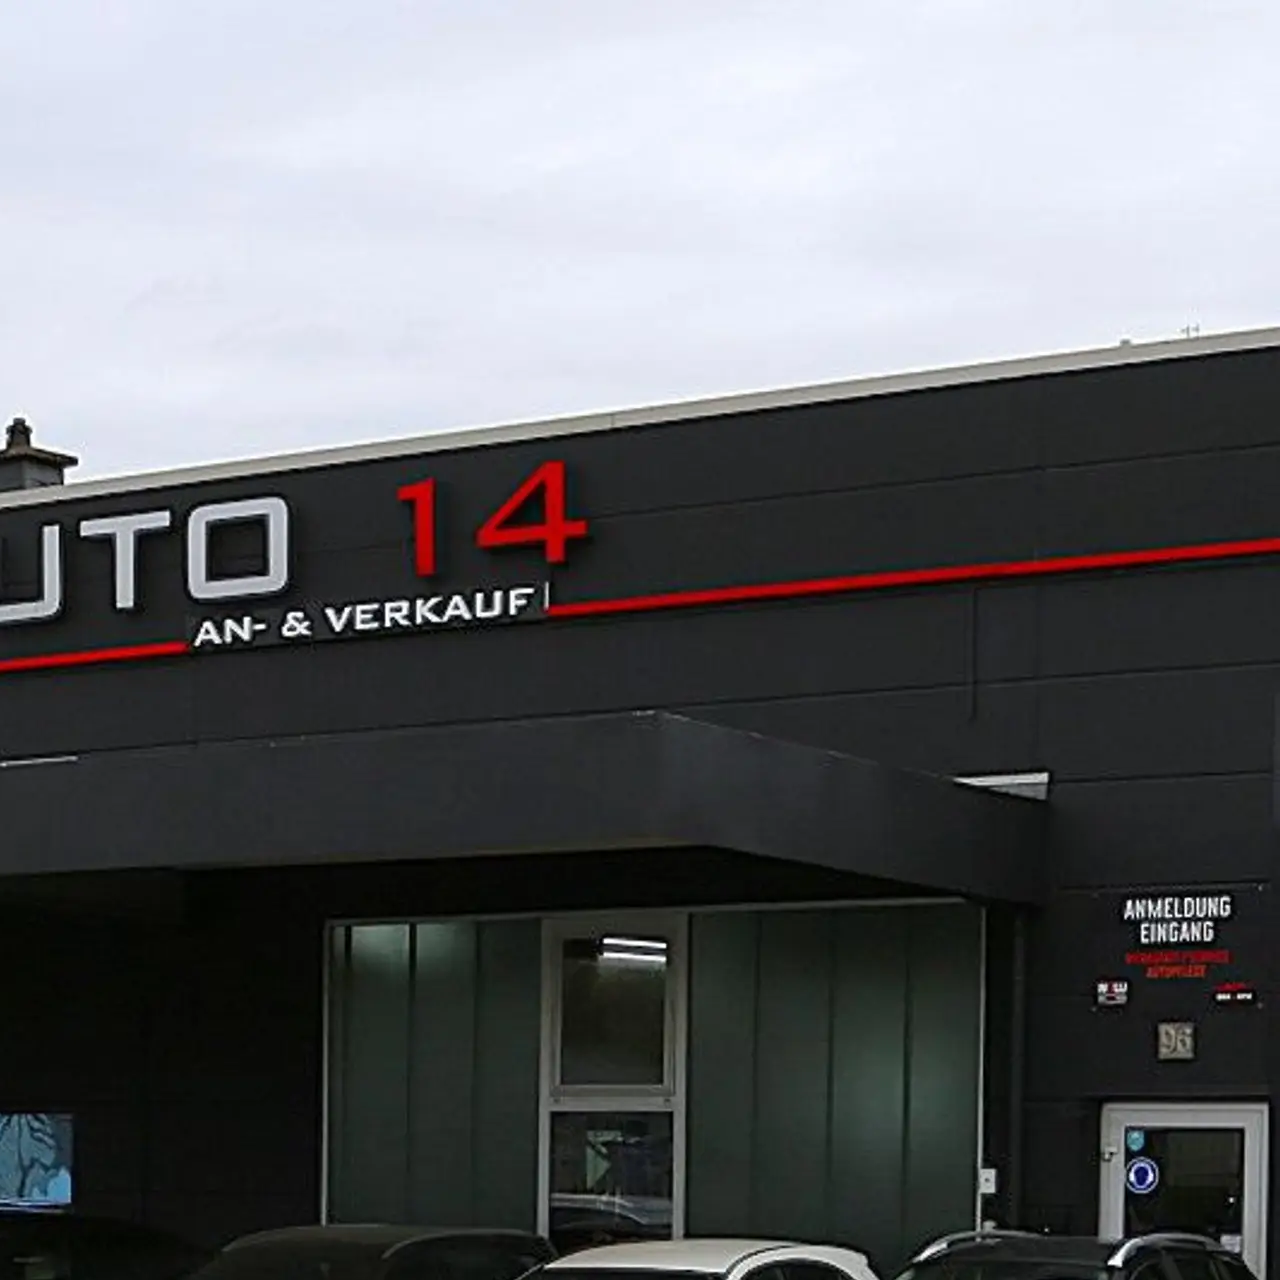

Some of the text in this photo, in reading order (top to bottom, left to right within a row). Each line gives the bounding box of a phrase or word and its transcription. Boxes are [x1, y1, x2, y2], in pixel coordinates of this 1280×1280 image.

[396, 459, 589, 578] 14
[193, 586, 536, 647] AN- & VERKAUF
[1123, 895, 1232, 920] ANMELDUNG
[1140, 920, 1215, 944] EINGANG
